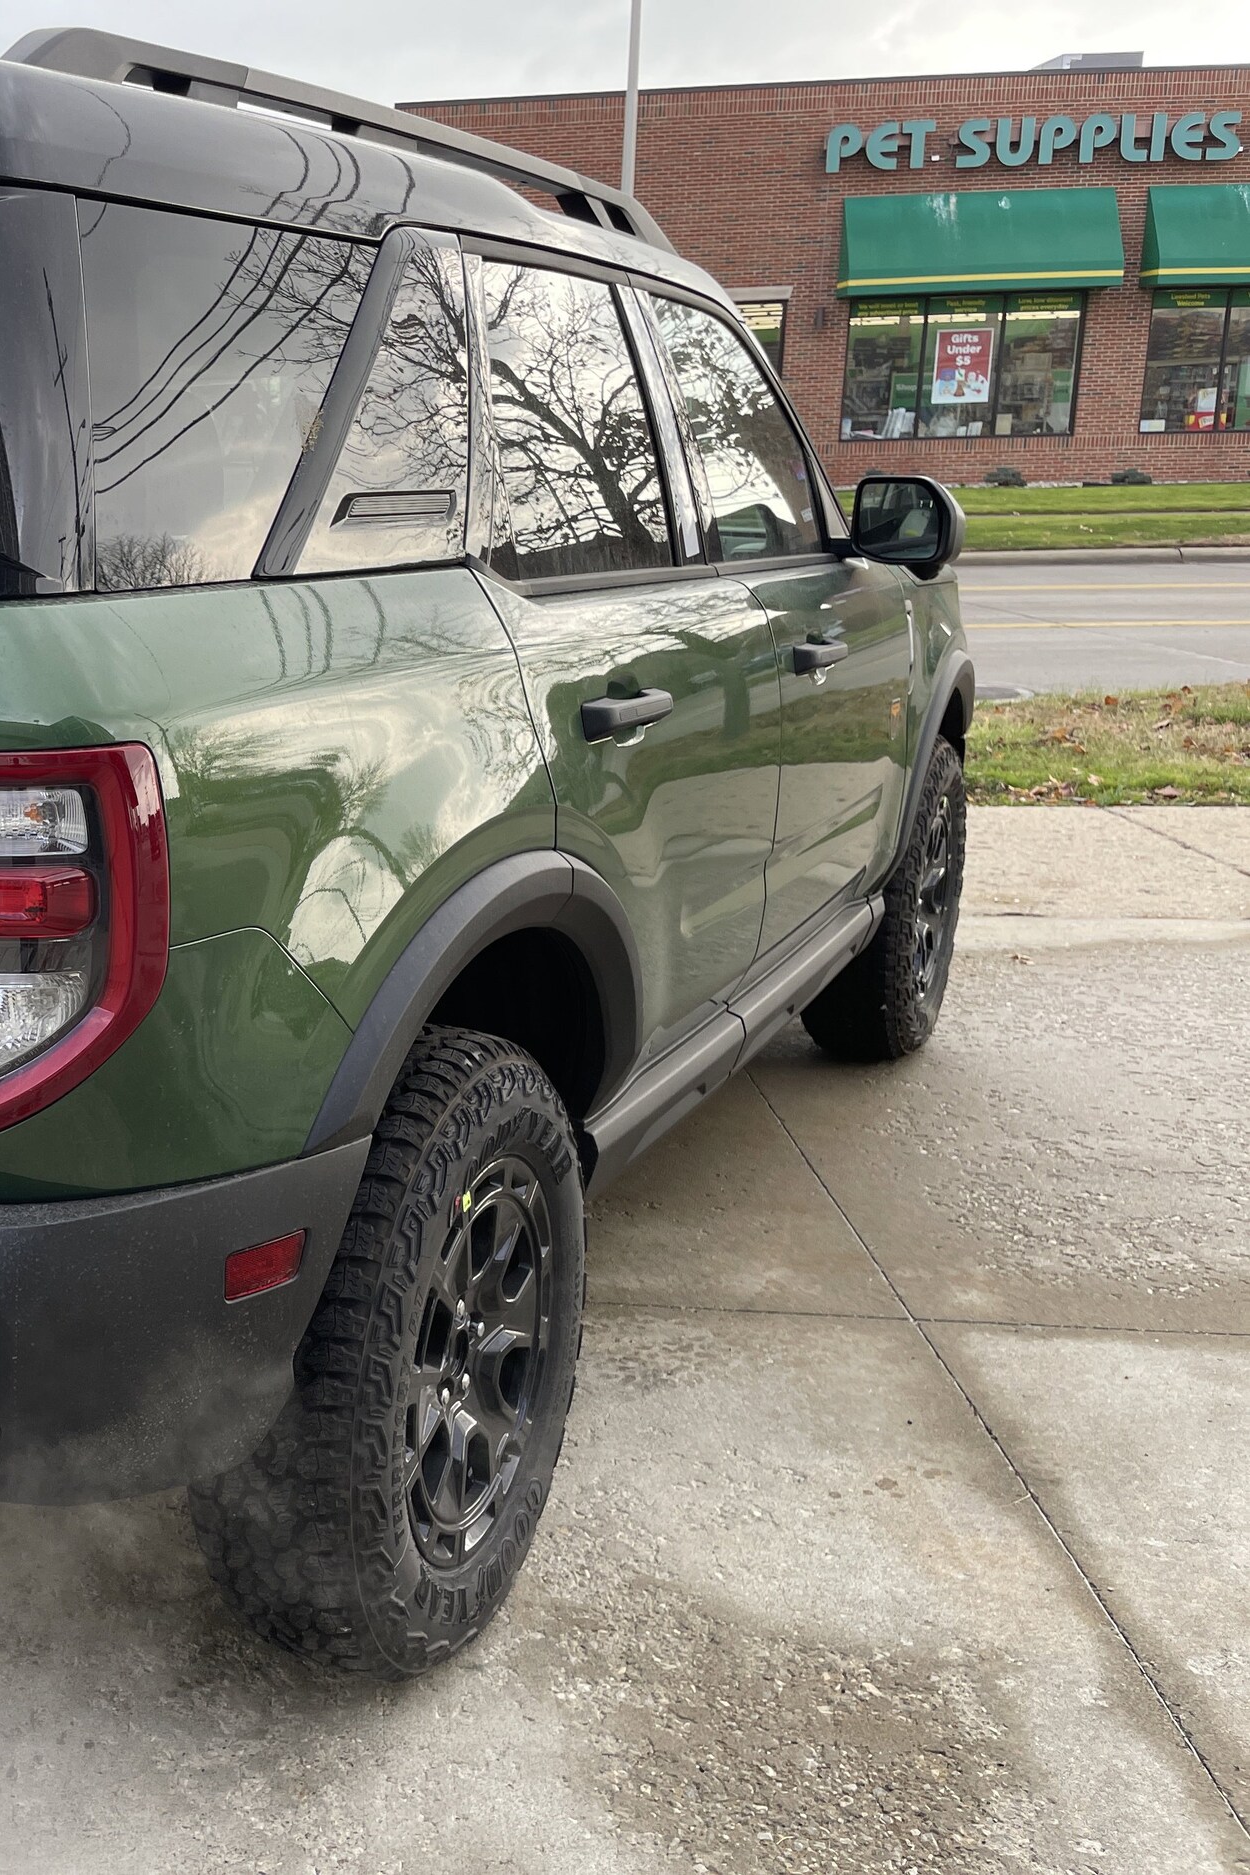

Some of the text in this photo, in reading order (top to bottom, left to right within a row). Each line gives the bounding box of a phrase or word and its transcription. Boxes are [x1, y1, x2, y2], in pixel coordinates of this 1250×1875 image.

[825, 111, 1242, 173] PET SUPPLIES
[950, 333, 979, 344] Gifts
[947, 344, 982, 355] Under
[956, 355, 971, 367] $5
